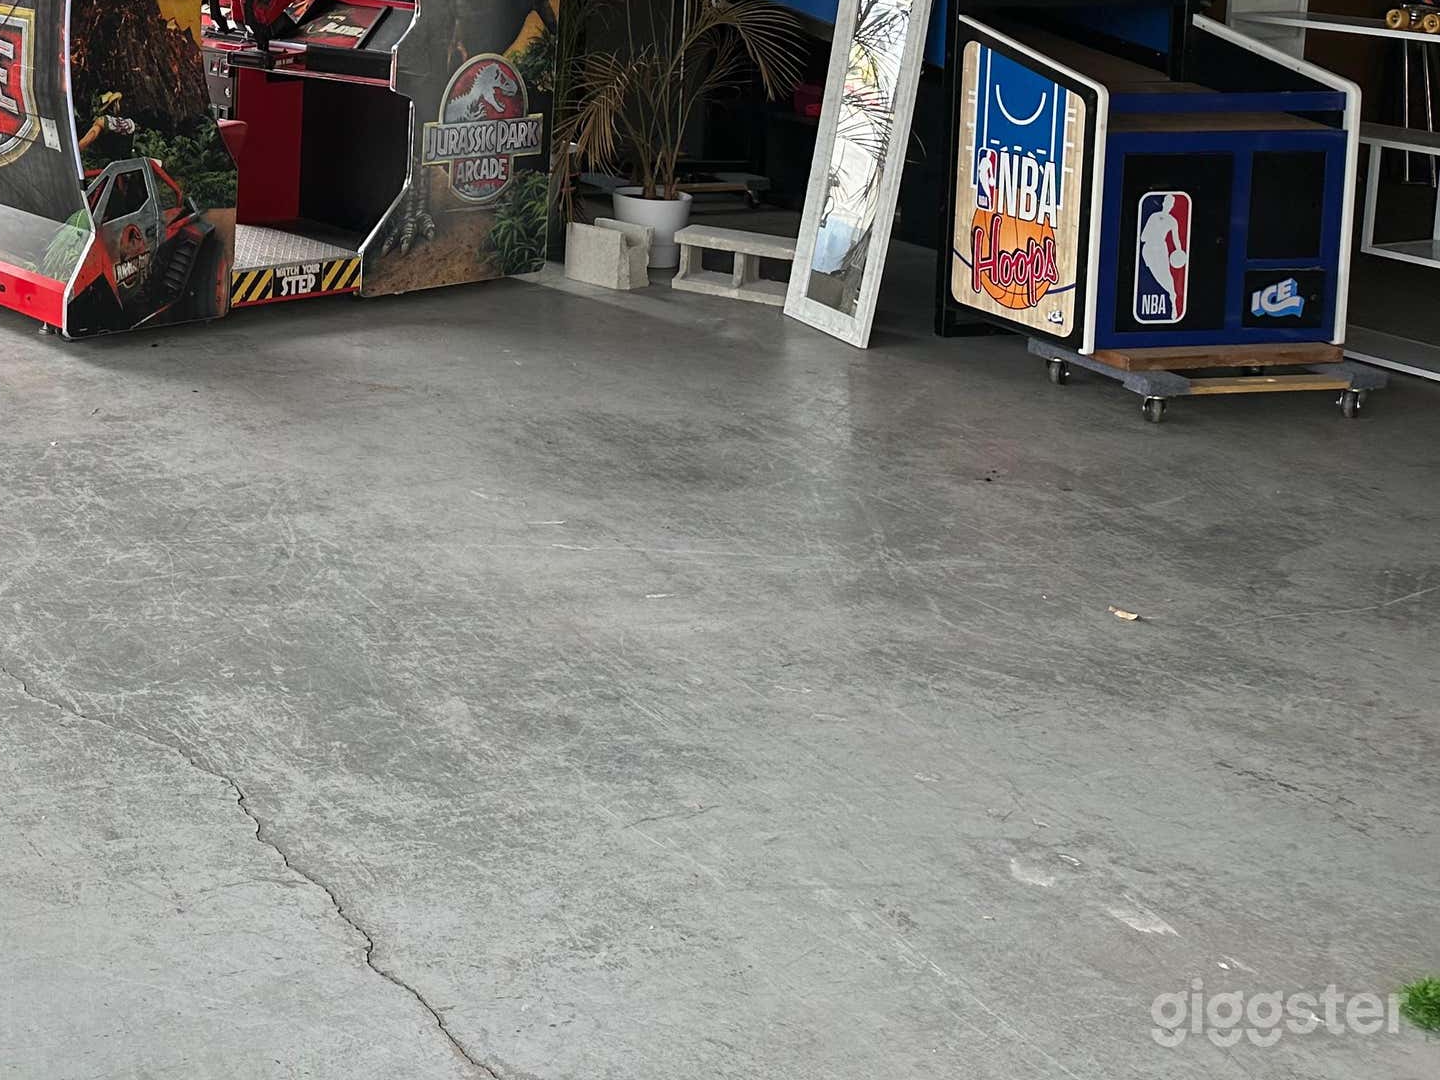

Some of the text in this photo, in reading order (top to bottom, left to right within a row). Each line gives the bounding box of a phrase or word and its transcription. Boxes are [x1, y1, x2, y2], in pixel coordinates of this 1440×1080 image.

[426, 120, 539, 161] JURASSIC PARK
[455, 158, 508, 183] ARCADE
[997, 148, 1059, 230] NBA
[275, 263, 321, 278] WATCH YOUR
[973, 215, 1059, 308] Hoops
[280, 273, 317, 297] STEP
[1250, 277, 1306, 319] ICE
[1141, 294, 1167, 316] NBA
